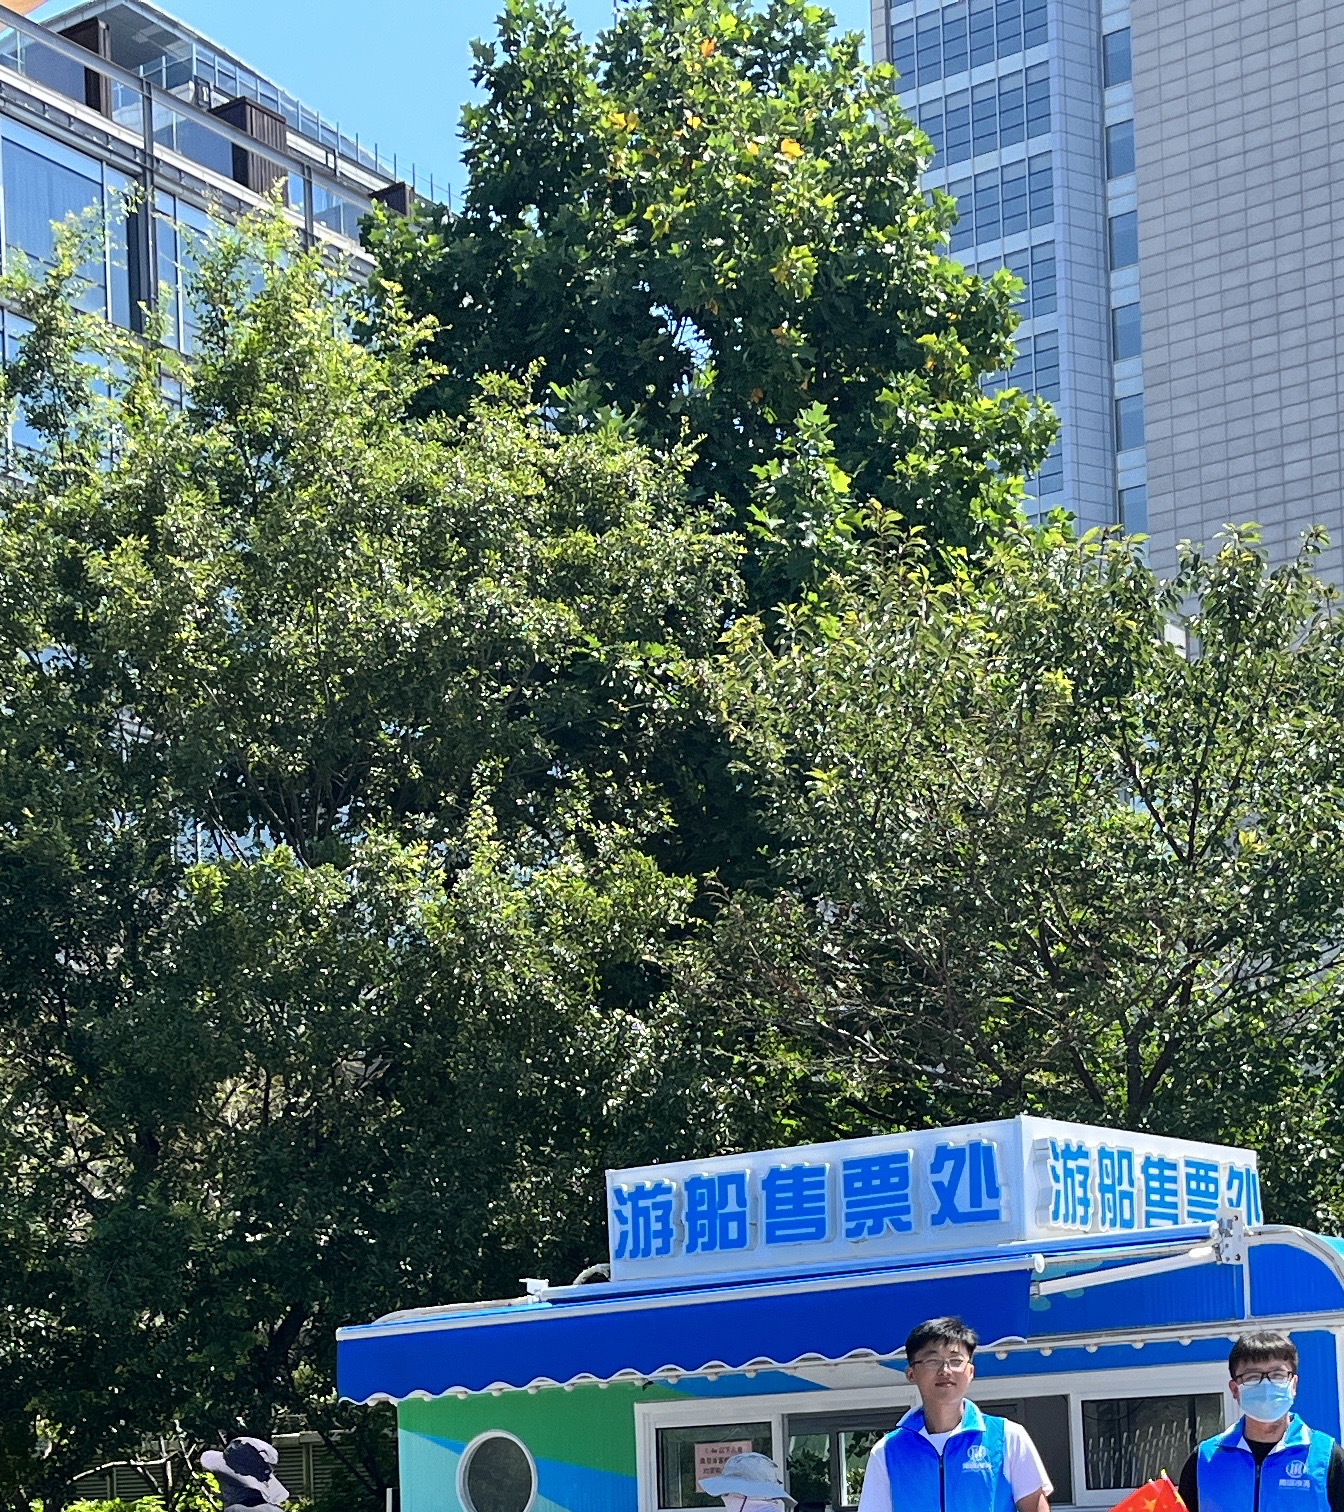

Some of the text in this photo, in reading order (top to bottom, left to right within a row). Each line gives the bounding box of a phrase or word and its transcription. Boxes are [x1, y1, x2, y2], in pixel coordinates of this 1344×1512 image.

[614, 1140, 1000, 1259] 游船售票处
[1050, 1140, 1262, 1229] 游船售票处
